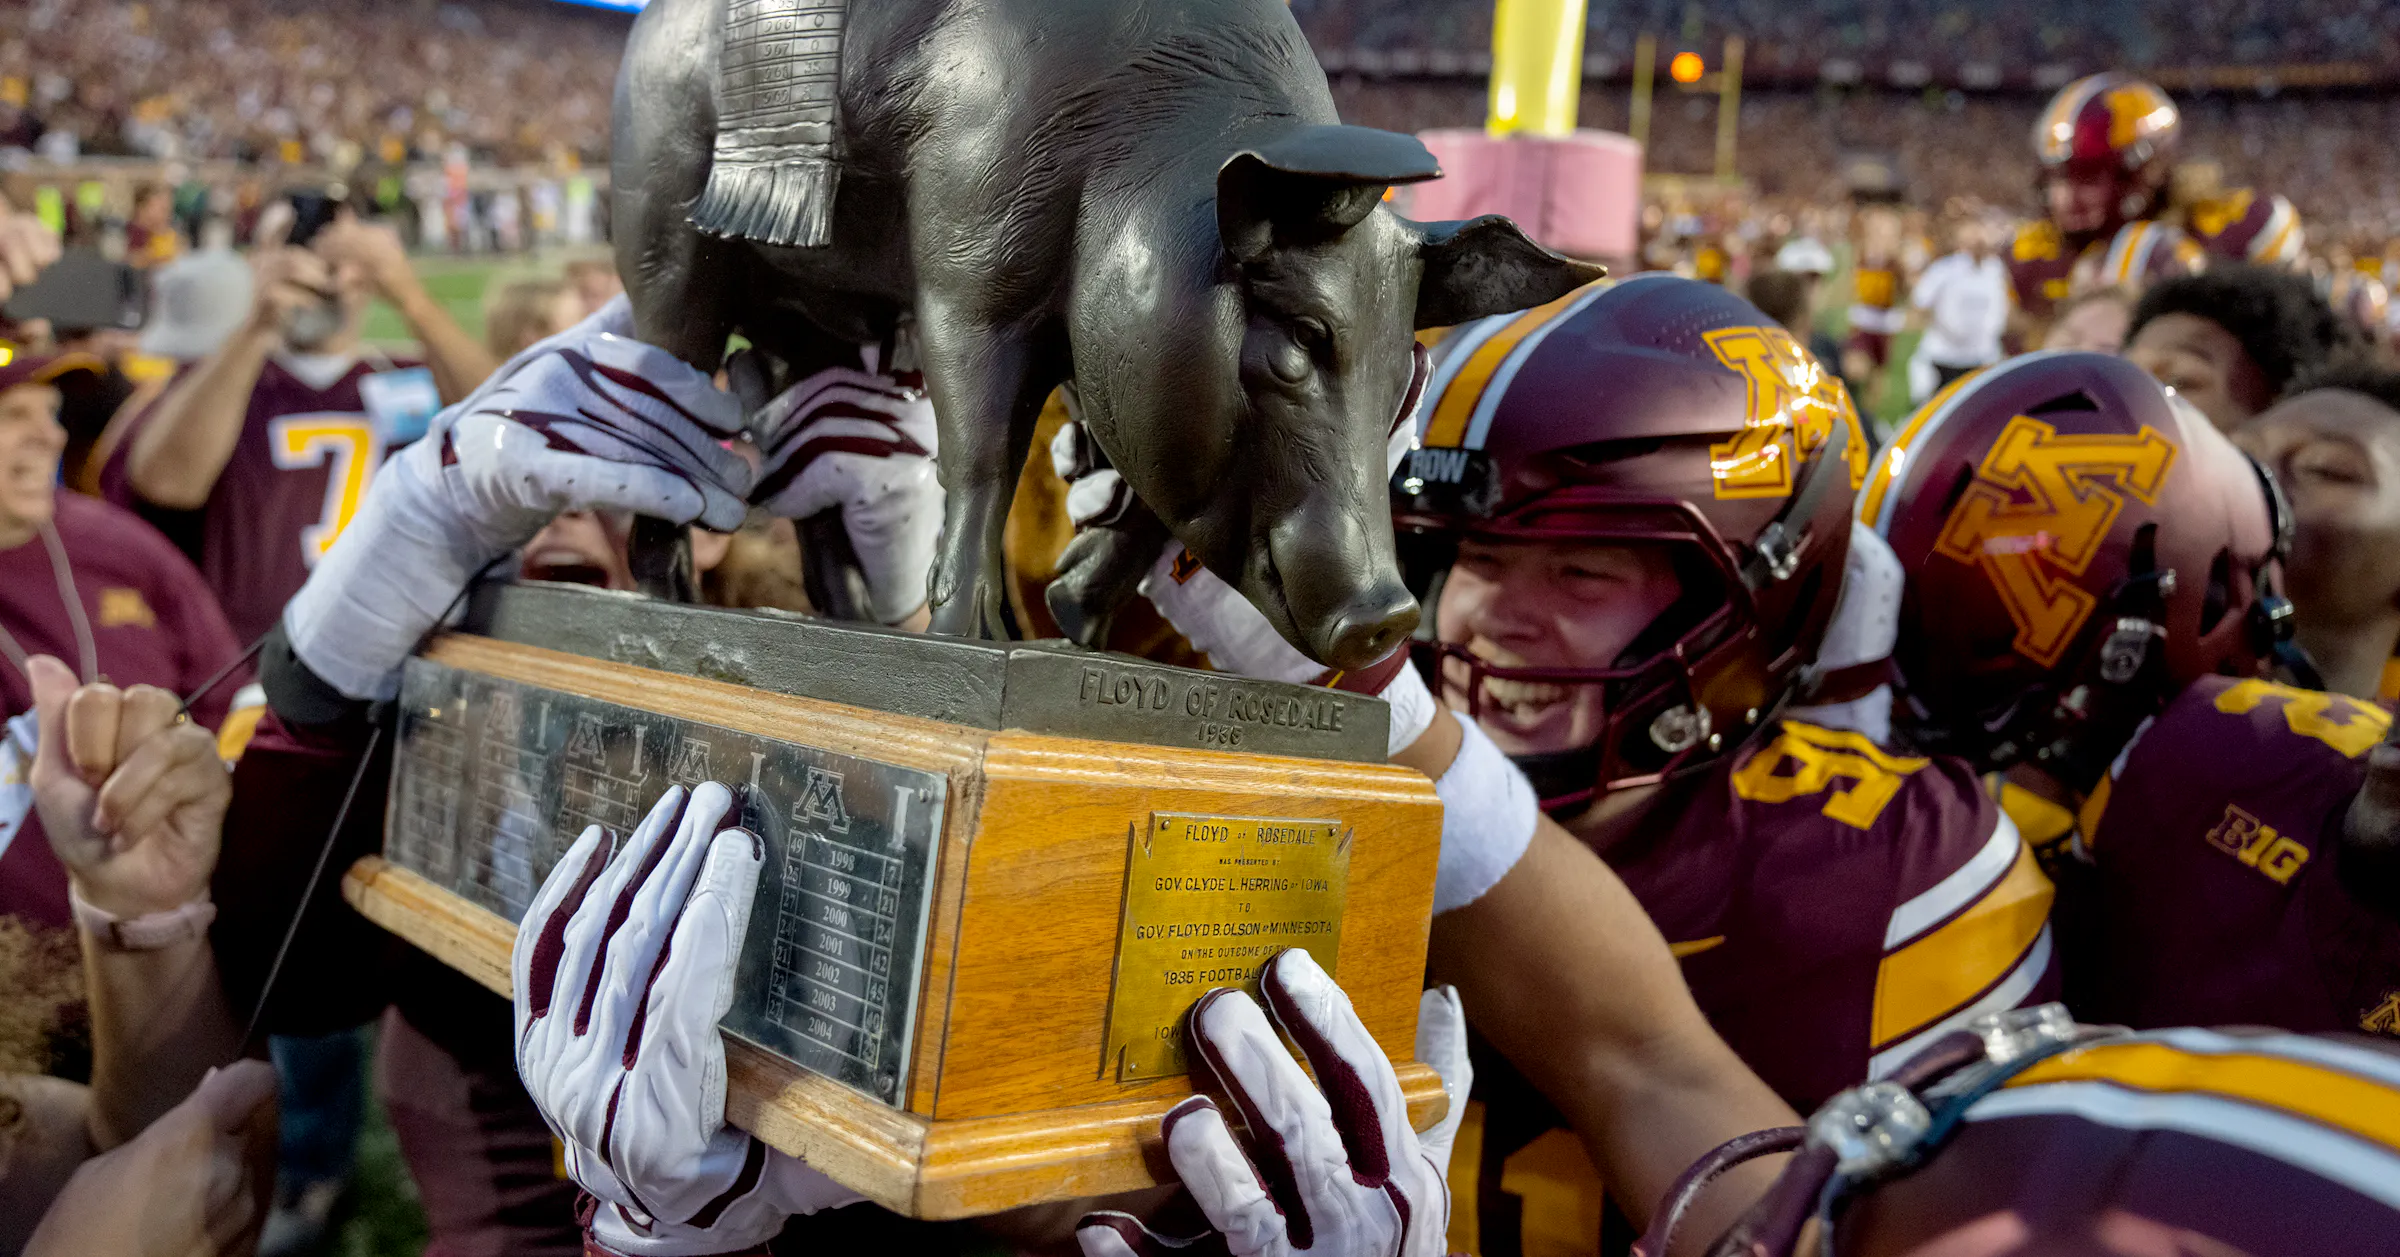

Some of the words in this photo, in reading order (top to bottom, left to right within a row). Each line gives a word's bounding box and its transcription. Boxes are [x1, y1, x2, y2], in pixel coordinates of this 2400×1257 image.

[814, 13, 825, 28] 0
[1079, 666, 1169, 710] FLOYD
[1186, 683, 1219, 717] OF
[1228, 686, 1345, 733] ROSEDALE
[791, 765, 851, 835] M
[1185, 824, 1229, 843] FLOYD
[1256, 826, 1317, 845] ROSEDALE
[829, 849, 856, 872] 1998
[1234, 858, 1269, 867] PRESENTED
[826, 877, 852, 900] 1999
[1155, 877, 1182, 892] GOV.
[1185, 877, 1225, 892] CLYDE
[1240, 877, 1288, 892] HERRING
[1301, 877, 1329, 892] IOWA
[822, 905, 849, 928] 2000
[1239, 902, 1251, 913] TO
[1168, 923, 1210, 938] FLOYD
[1269, 920, 1333, 936] MINNESOTA
[819, 933, 844, 957] 2001
[1181, 949, 1193, 960] ON
[1196, 948, 1214, 959] THE
[1217, 945, 1260, 958] OUTCOME
[1263, 945, 1273, 956] OF
[815, 960, 841, 985] 2002
[1164, 970, 1195, 985] 1935
[811, 988, 837, 1012] 2003
[807, 1016, 833, 1041] 2004
